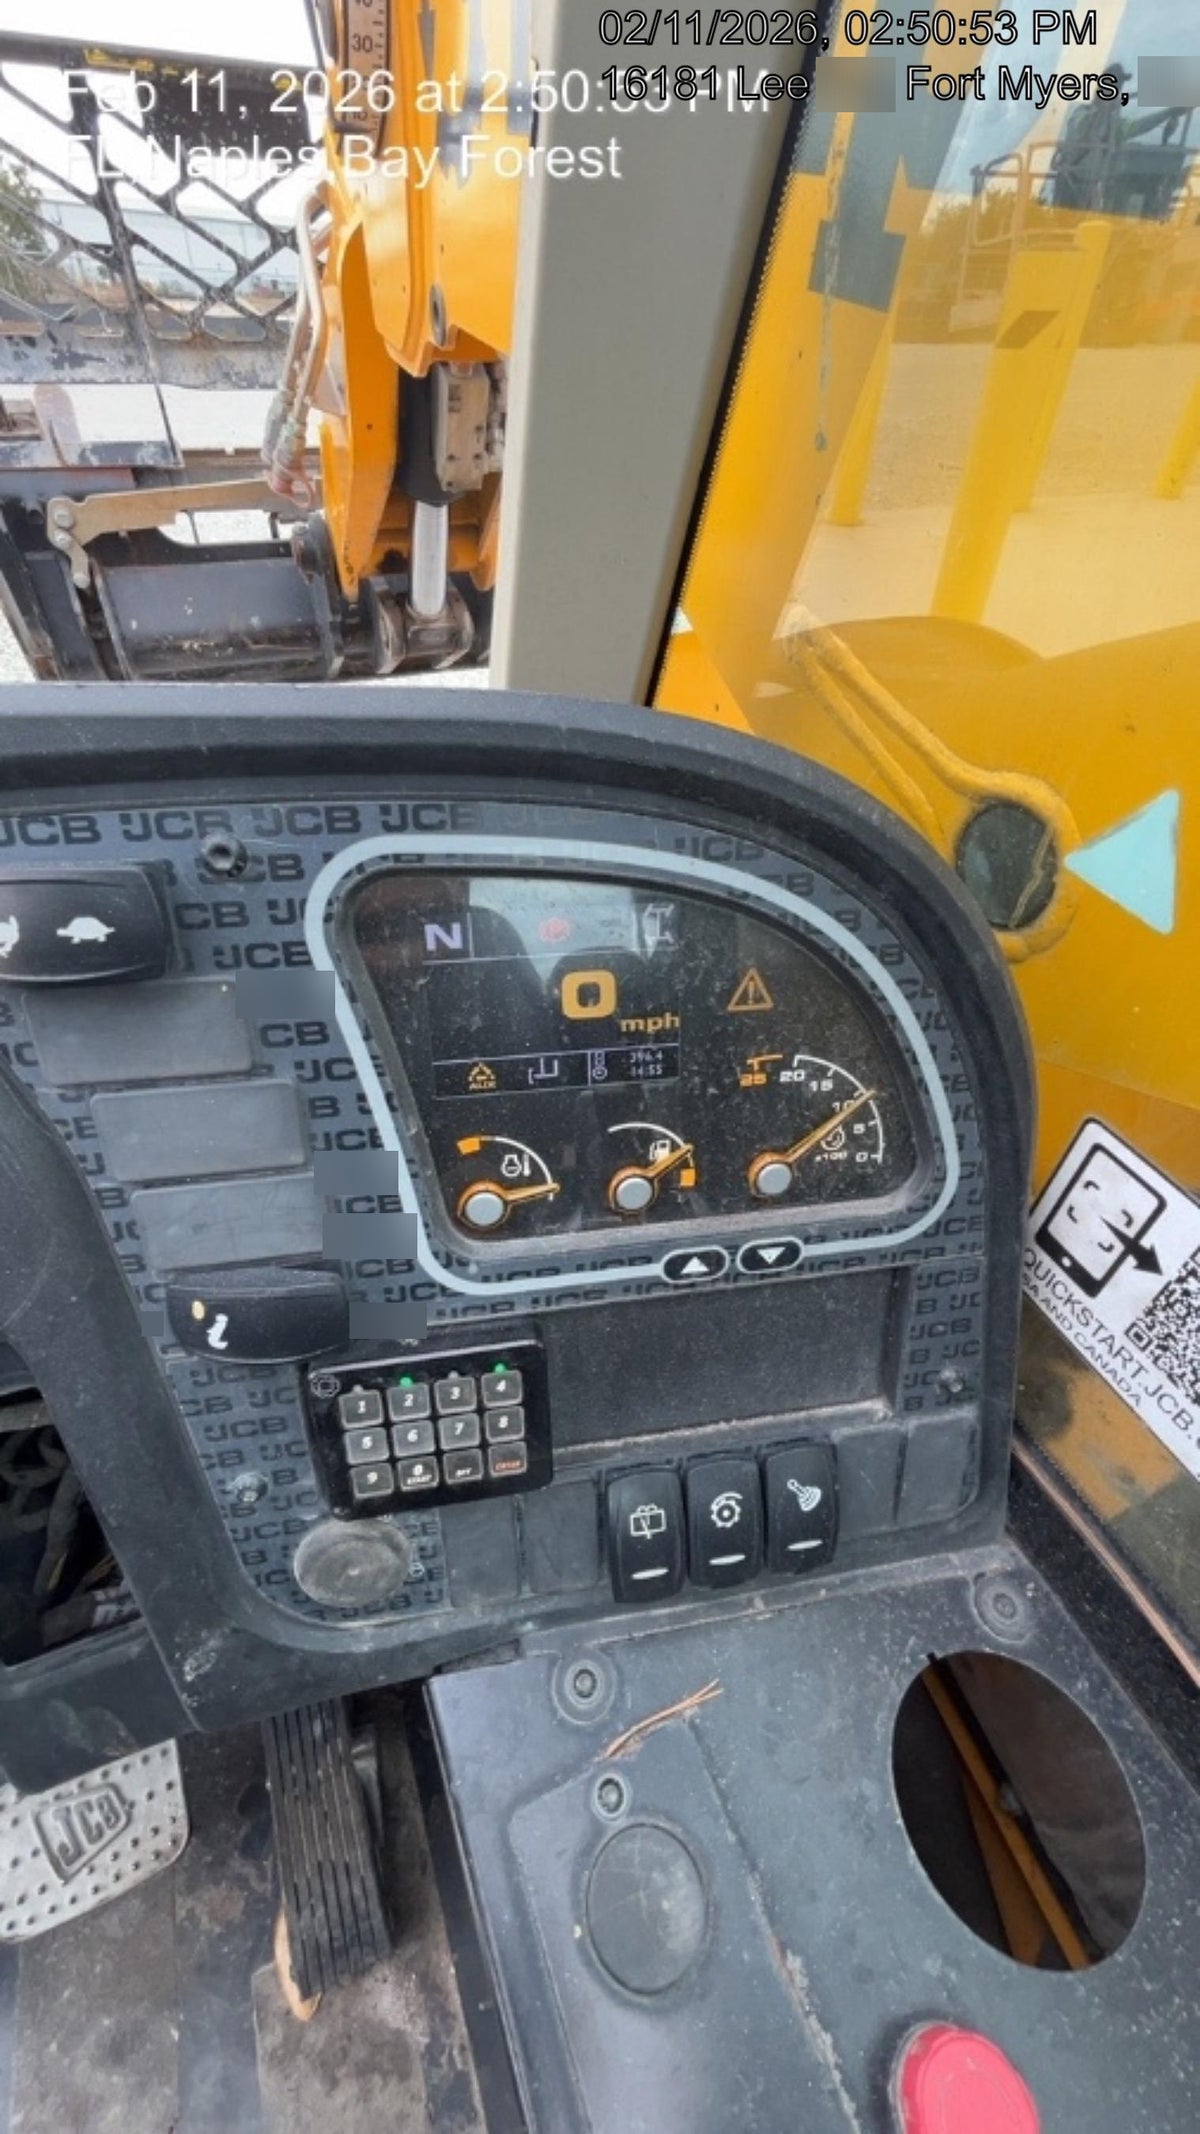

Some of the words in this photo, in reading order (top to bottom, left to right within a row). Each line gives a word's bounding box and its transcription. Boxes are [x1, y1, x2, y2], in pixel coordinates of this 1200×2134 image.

[252, 804, 361, 837] JCB
[424, 922, 463, 951] N
[561, 969, 618, 1020] 0
[620, 1012, 681, 1035] mph
[780, 1069, 805, 1083] 20
[853, 1123, 865, 1135] 5
[1023, 1249, 1200, 1449] QUICKSTART.JCB.
[1041, 1296, 1073, 1334] AND
[1073, 1332, 1143, 1408] CANADA
[357, 1401, 367, 1414] 1
[403, 1393, 414, 1408] 2
[450, 1386, 461, 1401] 3
[496, 1379, 507, 1393] 4
[204, 1416, 287, 1442] JCB
[362, 1435, 373, 1450] 5
[407, 1428, 418, 1444] 6
[455, 1421, 466, 1436] 7
[498, 1414, 509, 1430] 8
[367, 1471, 379, 1486] 9
[412, 1464, 424, 1477] 0
[51, 1791, 121, 1867] JCB
